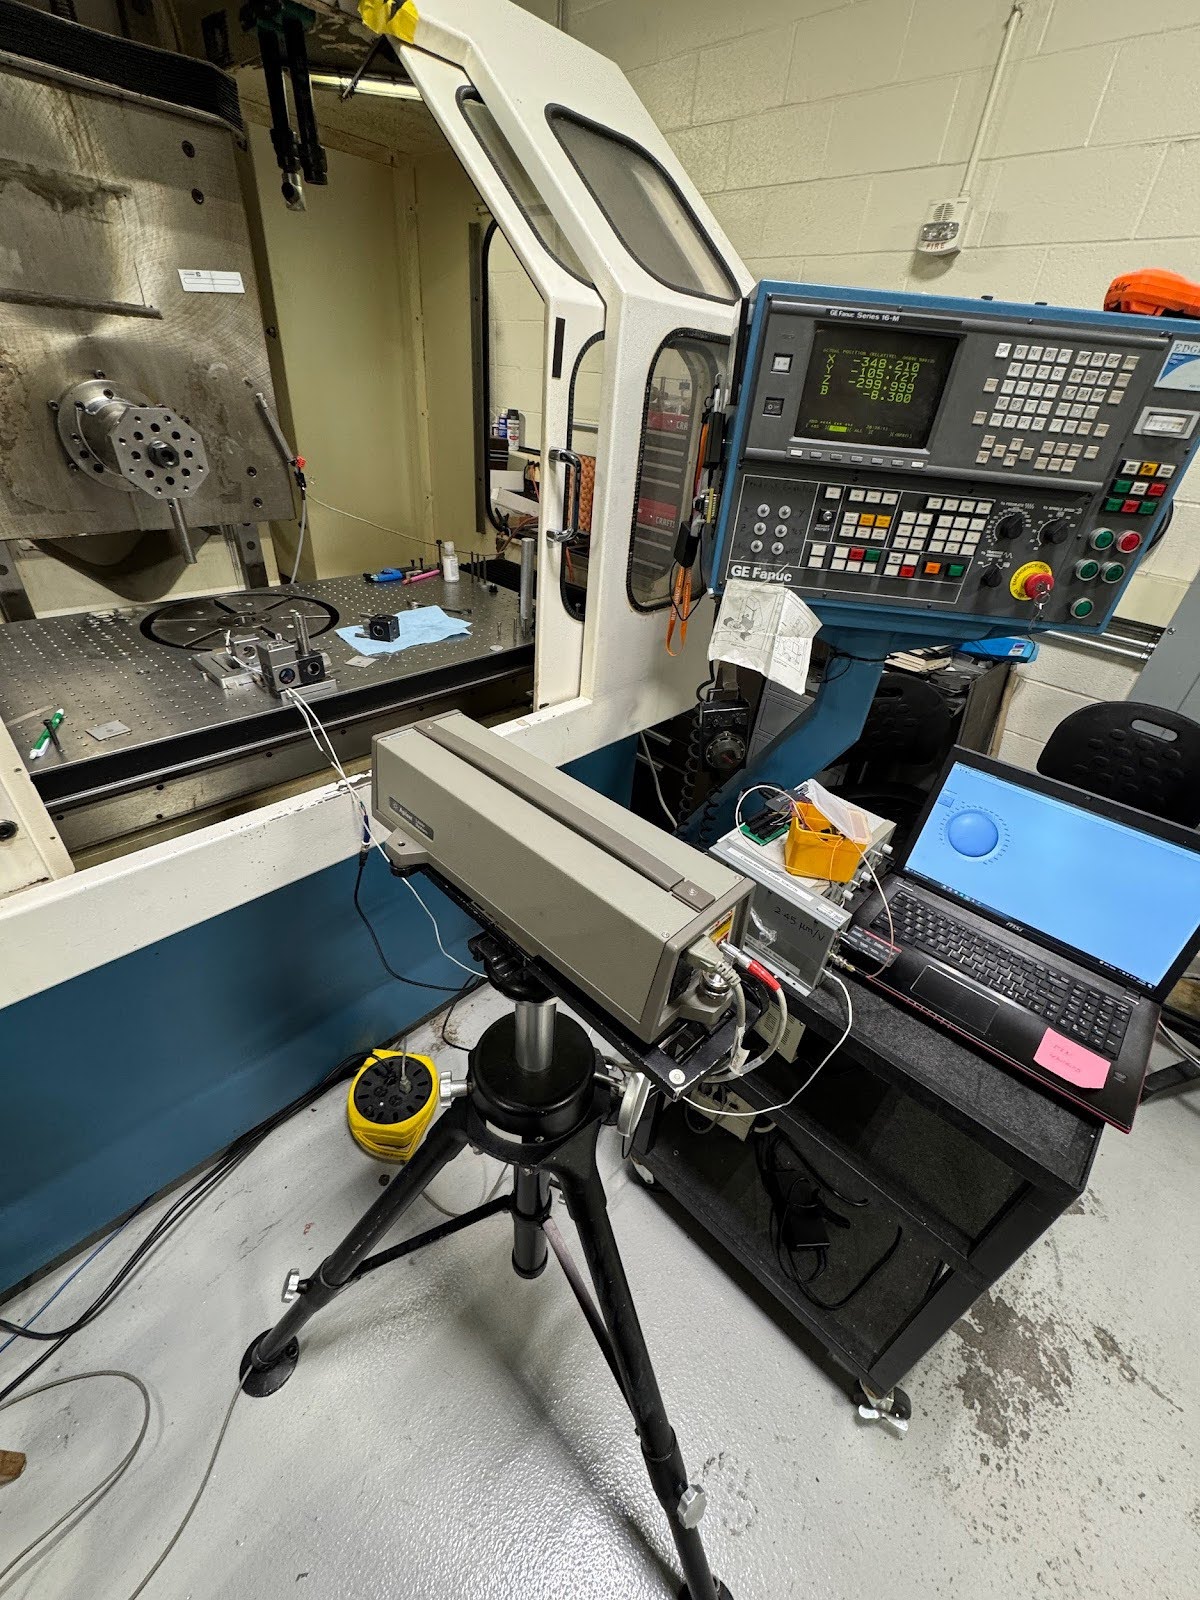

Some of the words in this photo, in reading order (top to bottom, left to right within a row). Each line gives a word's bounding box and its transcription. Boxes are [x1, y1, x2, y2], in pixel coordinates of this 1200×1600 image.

[857, 312, 880, 320] Series
[882, 314, 900, 322] 16-M
[1173, 343, 1200, 354] EDG
[827, 354, 836, 364] X
[853, 357, 920, 373] -348.210
[826, 364, 834, 374] Y
[850, 367, 918, 383] -105.727
[822, 375, 831, 385] Z
[848, 378, 915, 393] -299.999
[820, 386, 829, 395] B
[863, 391, 912, 404] -8.300
[730, 564, 751, 578] GE
[752, 566, 793, 582] Fanuc
